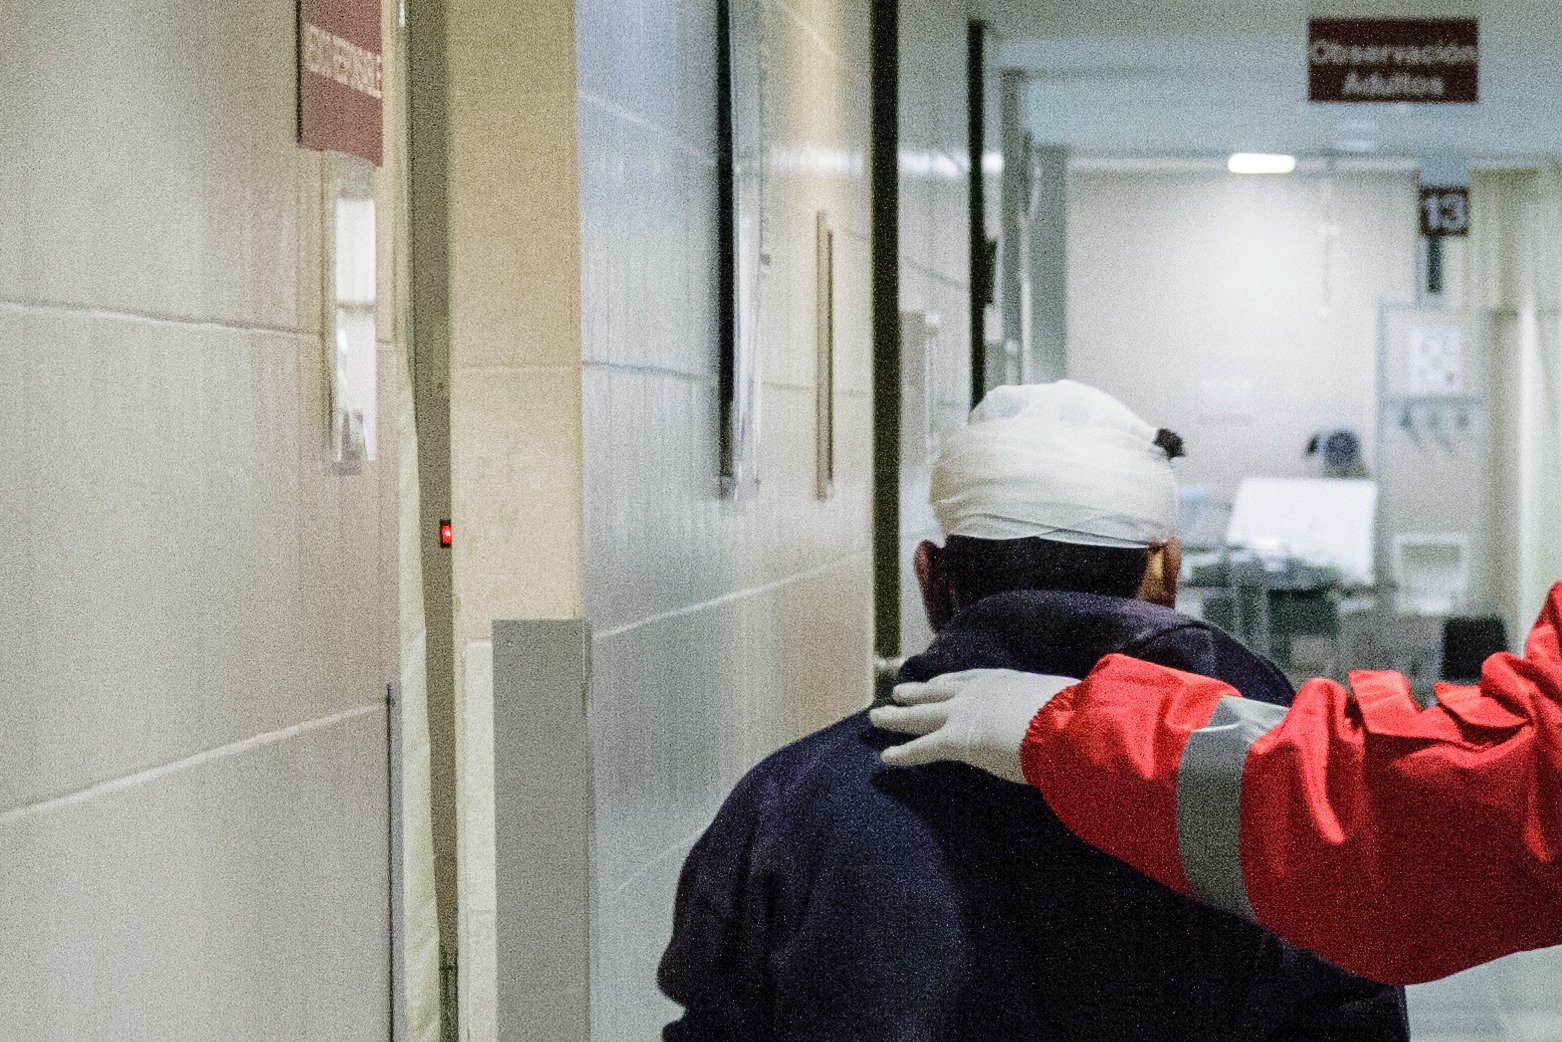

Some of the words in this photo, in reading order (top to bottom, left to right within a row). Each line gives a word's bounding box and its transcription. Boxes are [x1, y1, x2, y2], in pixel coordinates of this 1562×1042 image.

[1310, 40, 1477, 65] Observación
[1342, 70, 1444, 96] Adultos
[1426, 194, 1465, 230] 13
